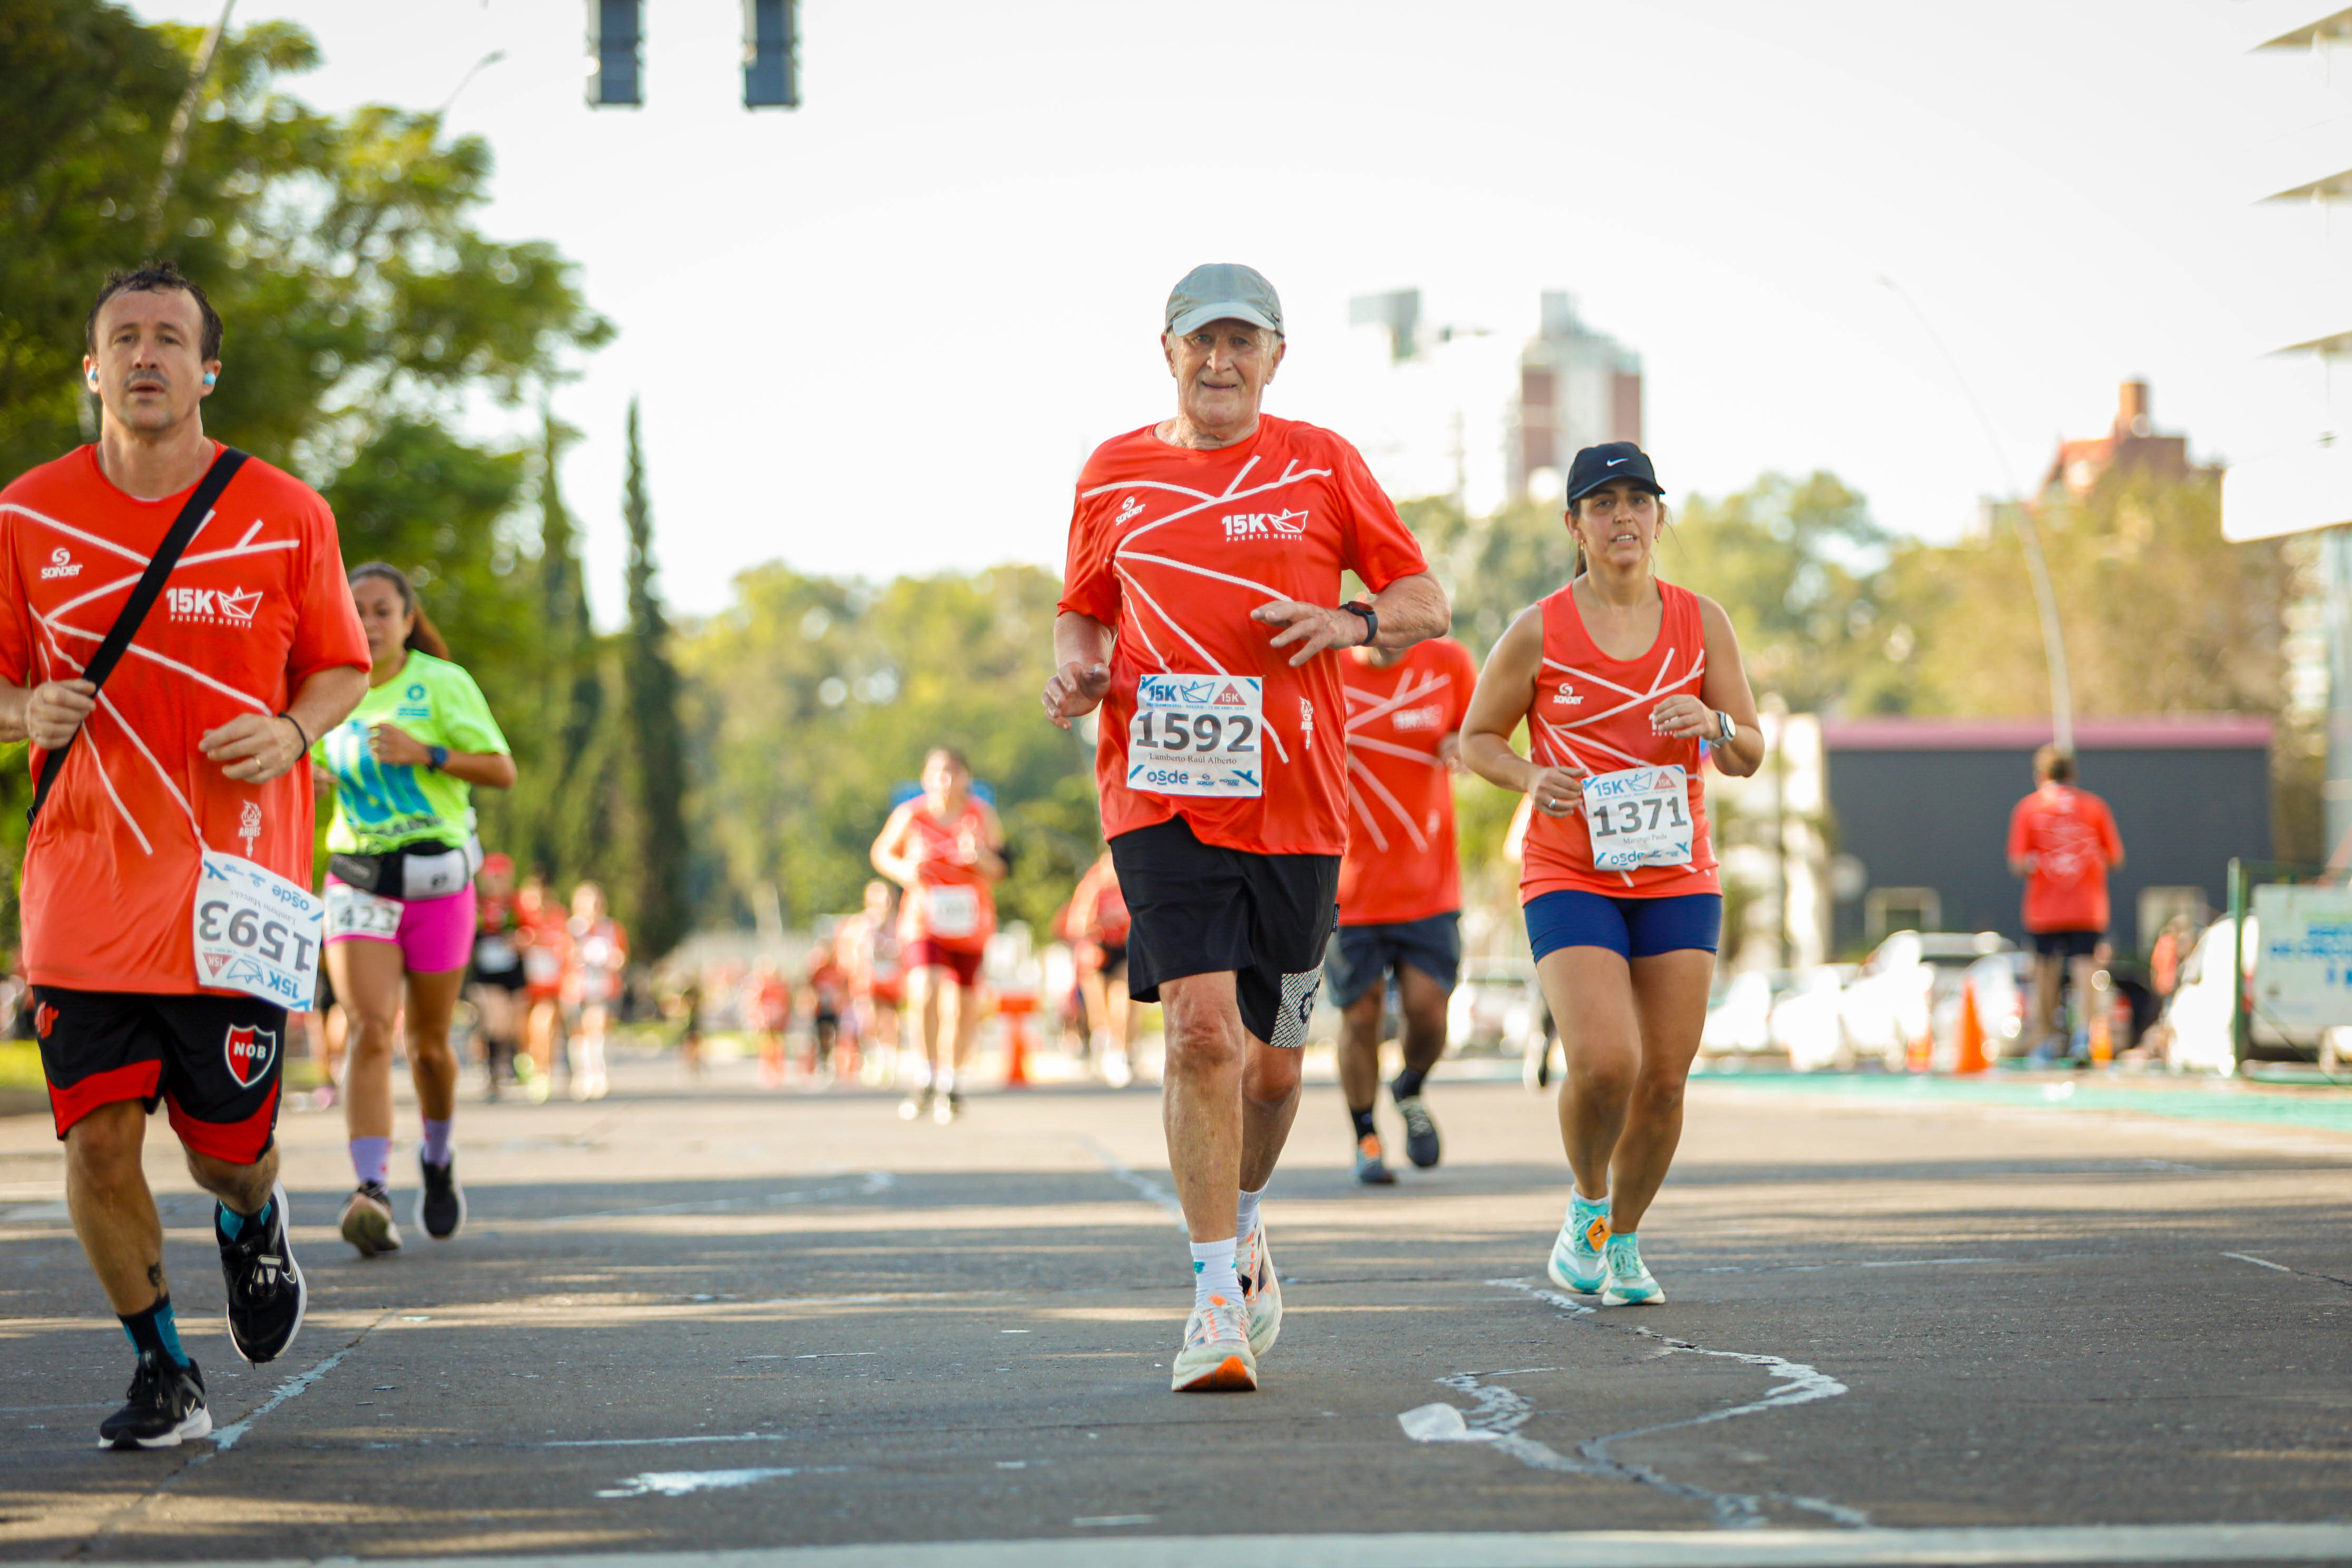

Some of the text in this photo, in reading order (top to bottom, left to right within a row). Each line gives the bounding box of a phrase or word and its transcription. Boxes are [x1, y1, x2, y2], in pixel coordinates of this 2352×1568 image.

[1222, 513, 1268, 536] 15K
[166, 588, 215, 614] 15K
[171, 614, 252, 628] PUERTO NORTE
[1149, 685, 1177, 702] 15K
[1221, 693, 1239, 702] 15K
[1136, 711, 1255, 752] 1592
[1150, 752, 1185, 762] Lamberto
[1146, 769, 1189, 785] osde
[1594, 779, 1625, 796] 15K
[1593, 796, 1688, 837] 1371
[272, 885, 310, 910] osde
[264, 903, 296, 926] Lamberto
[199, 900, 314, 972] 1593
[209, 956, 224, 967] 15K
[267, 970, 299, 999] 15K
[234, 1042, 267, 1059] NOB
